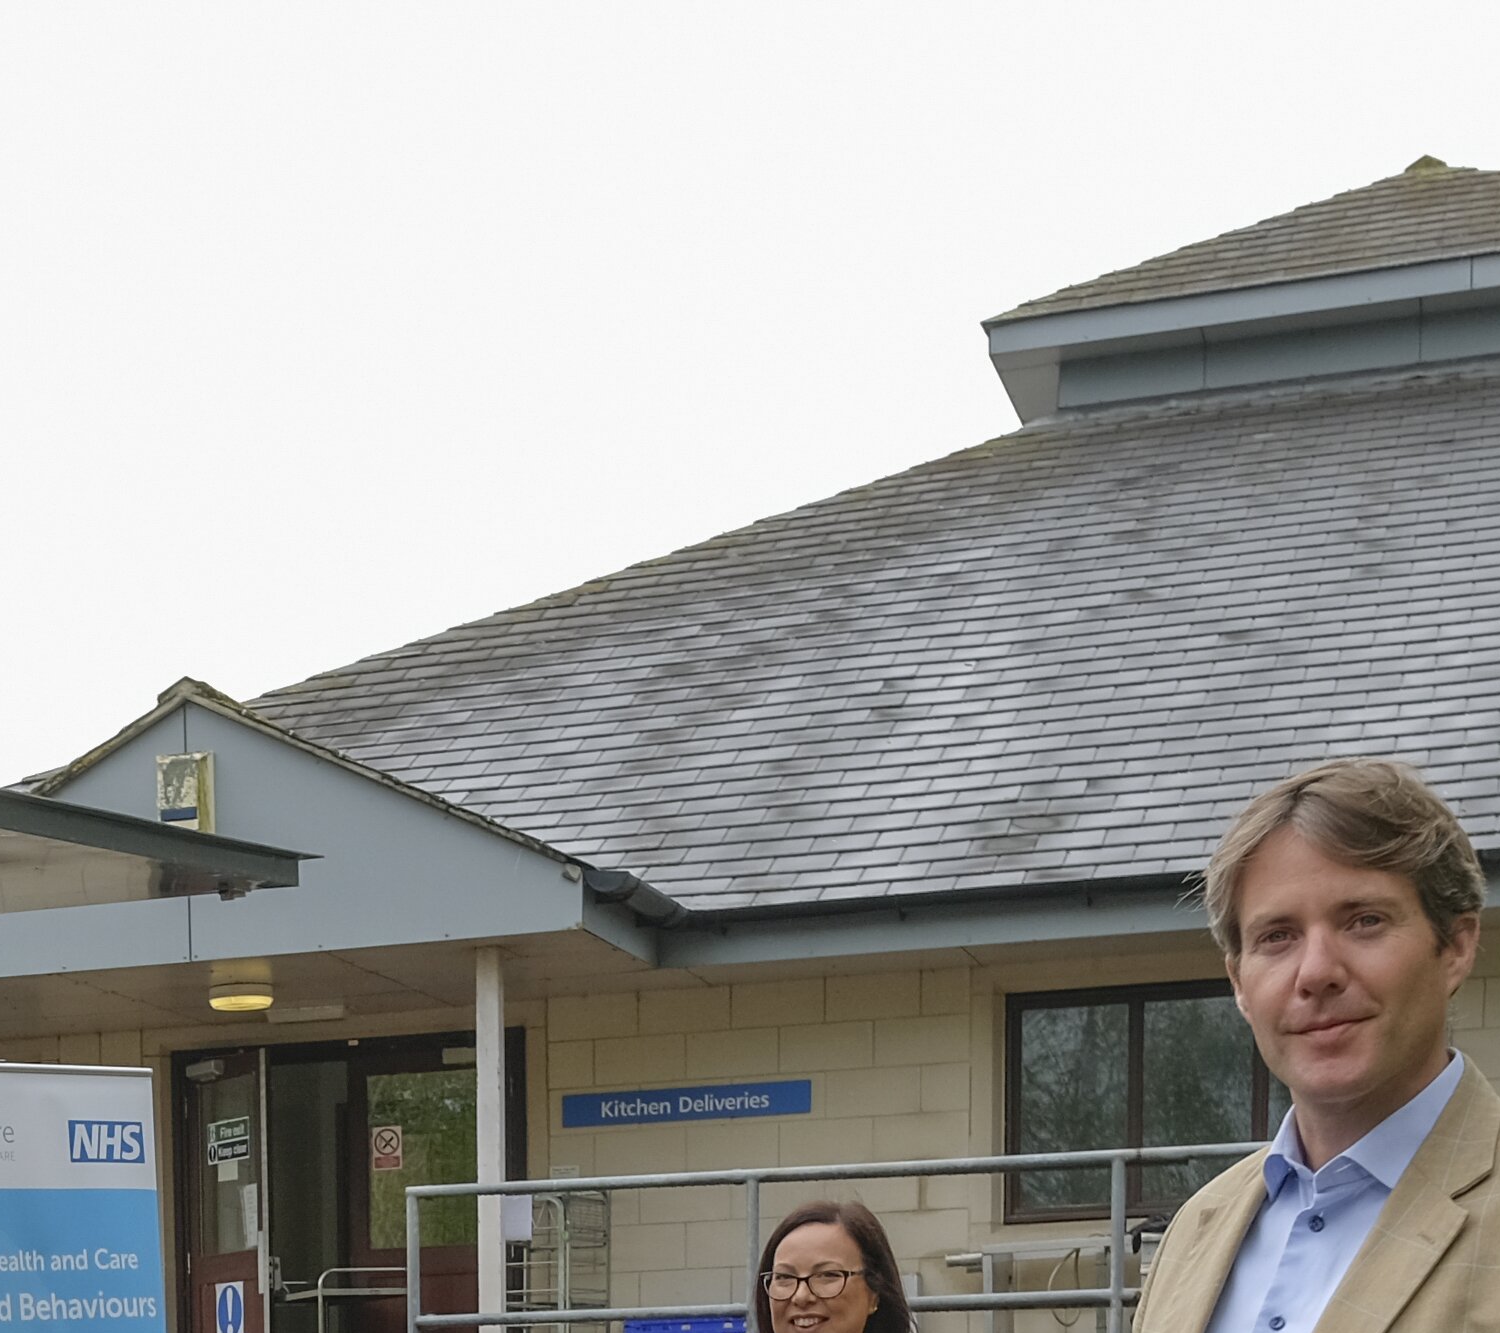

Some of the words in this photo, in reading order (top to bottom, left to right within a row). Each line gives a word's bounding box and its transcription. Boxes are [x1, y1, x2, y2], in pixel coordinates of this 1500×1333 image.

[600, 1099, 671, 1118] Kitchen
[679, 1092, 769, 1114] Deliveries
[72, 1124, 141, 1160] NHS
[220, 1126, 232, 1139] Fire
[51, 1249, 88, 1271] and
[94, 1247, 138, 1270] Care
[20, 1291, 157, 1321] Behaviours
